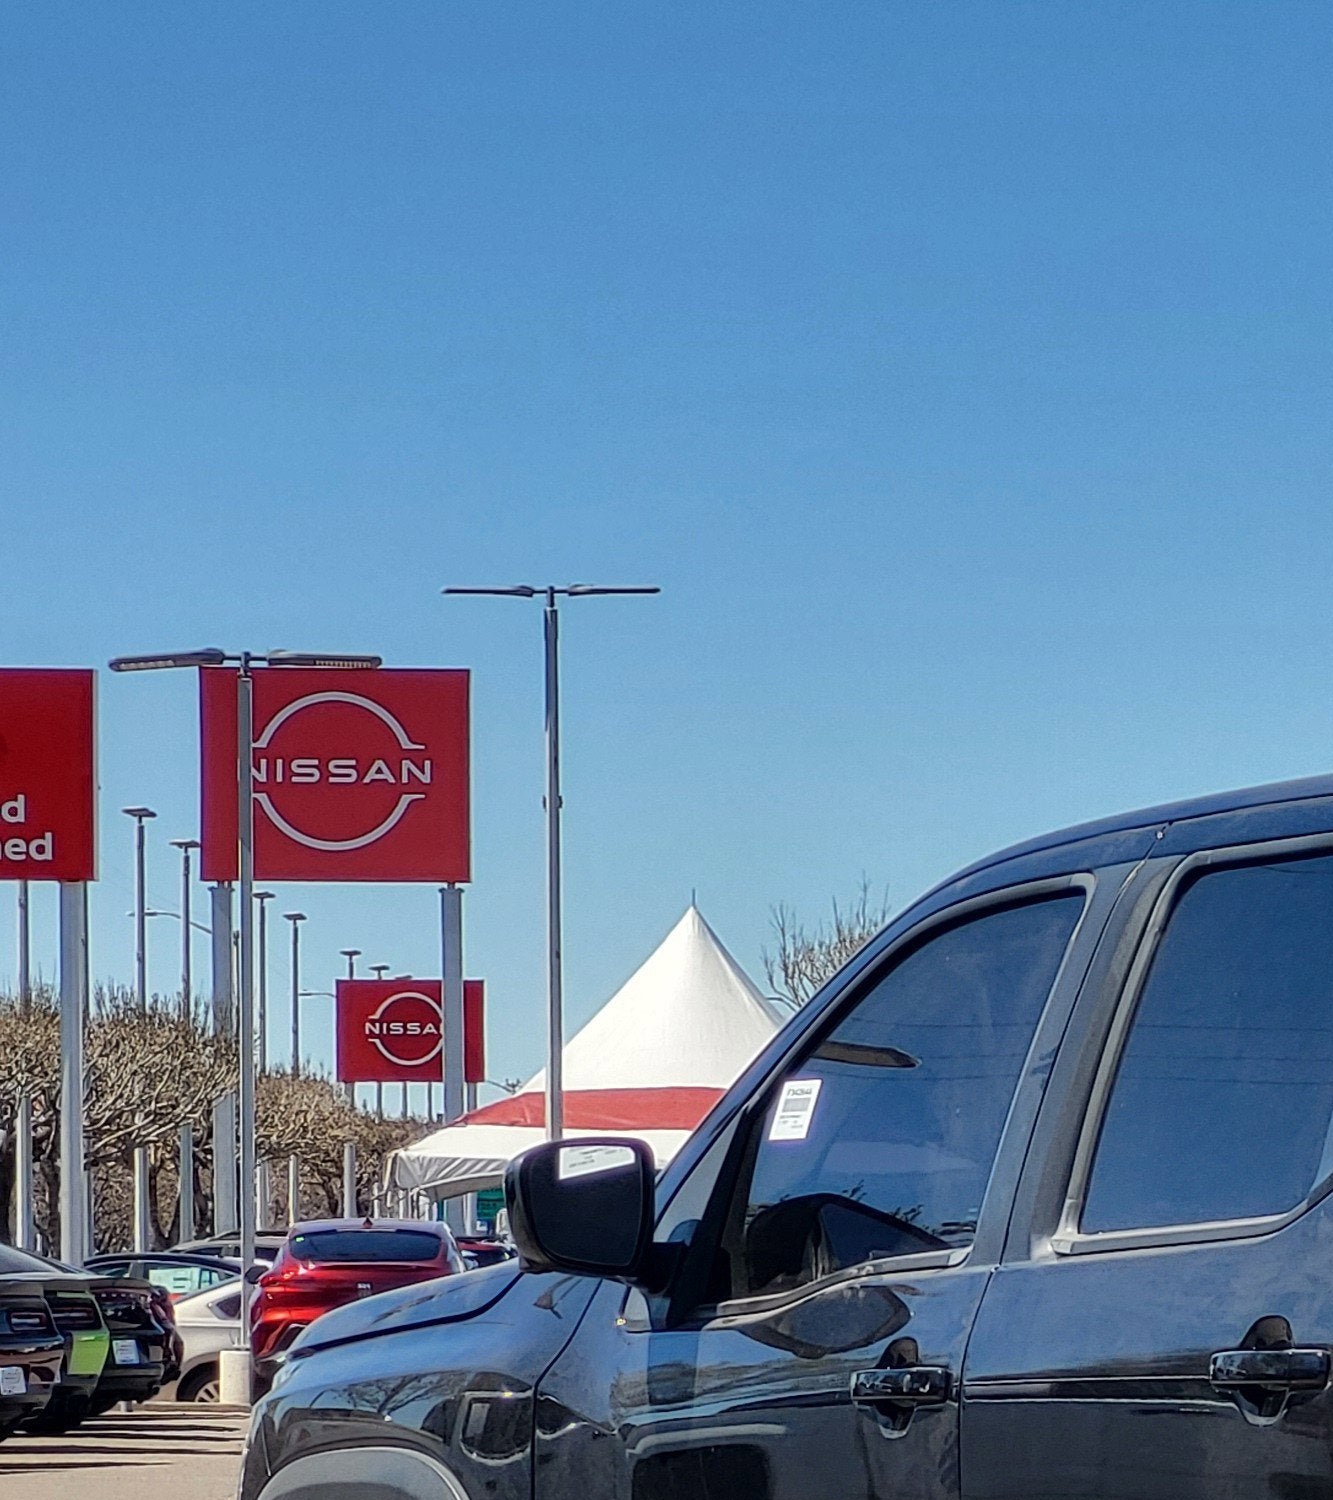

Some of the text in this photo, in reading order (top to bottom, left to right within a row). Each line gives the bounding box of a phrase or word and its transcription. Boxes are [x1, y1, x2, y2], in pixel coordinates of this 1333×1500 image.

[237, 758, 431, 783] NISSAN
[0, 832, 53, 861] ed
[365, 1022, 444, 1035] NISSA
